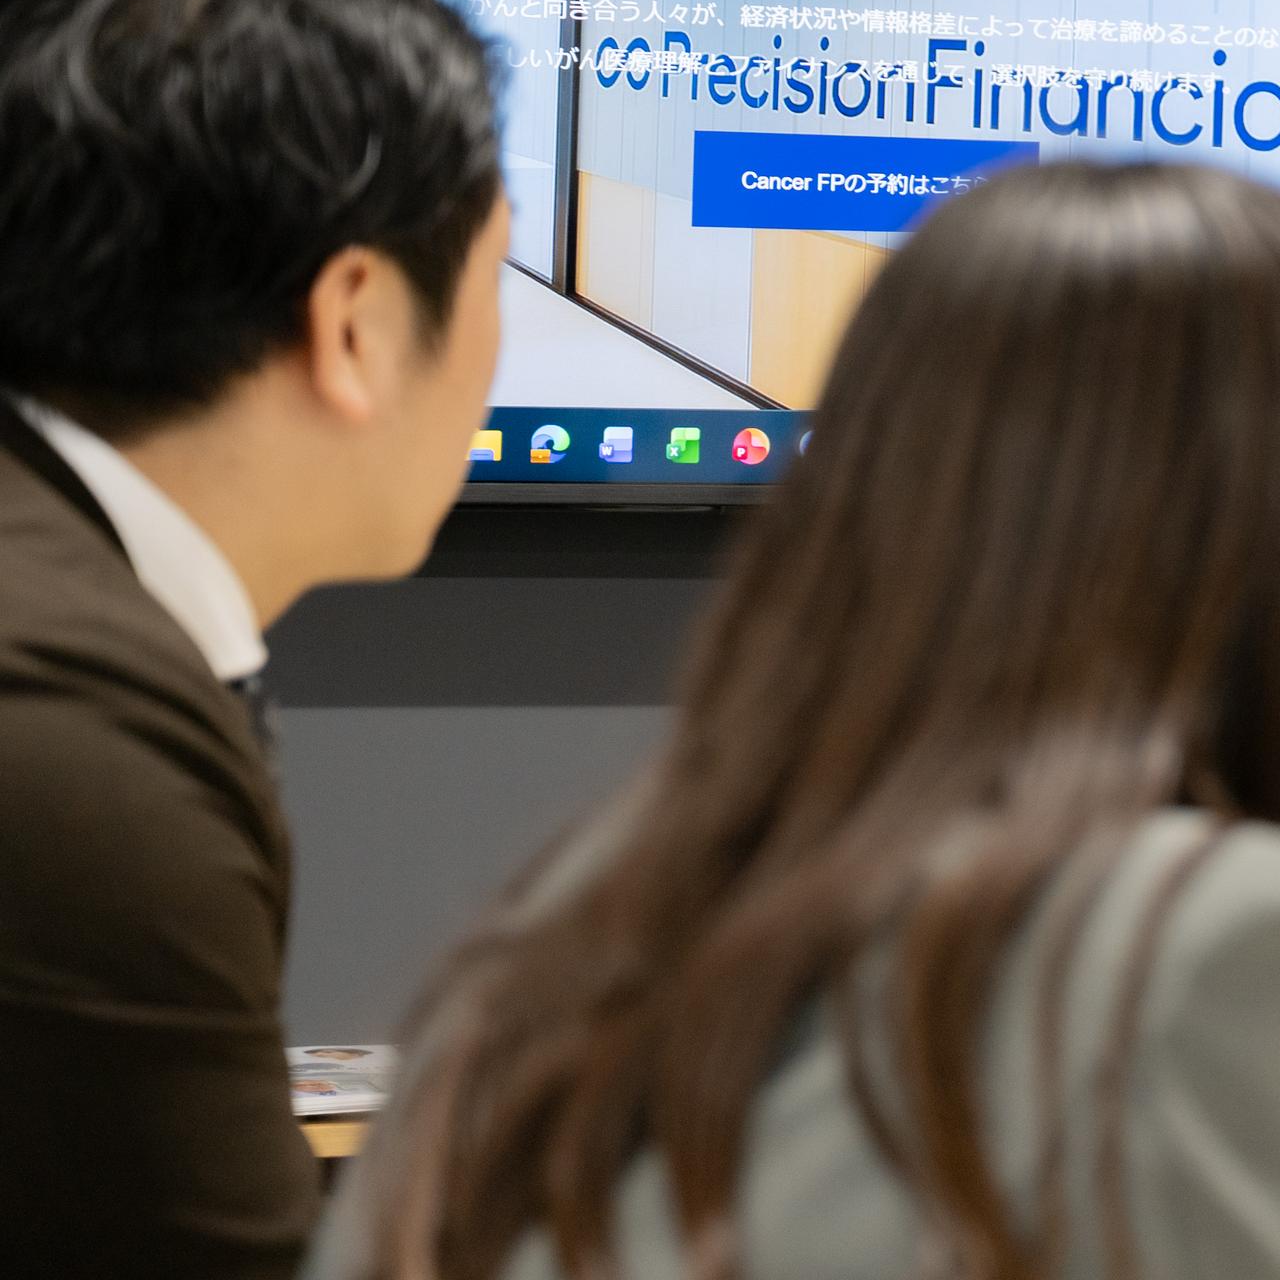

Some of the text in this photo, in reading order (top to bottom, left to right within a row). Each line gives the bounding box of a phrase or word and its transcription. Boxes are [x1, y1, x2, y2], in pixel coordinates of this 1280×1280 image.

[485, 42, 1232, 95] しいがん医療理解とファイナンスを通じて、選択肢を守り続けます。
[741, 170, 813, 192] Cancer
